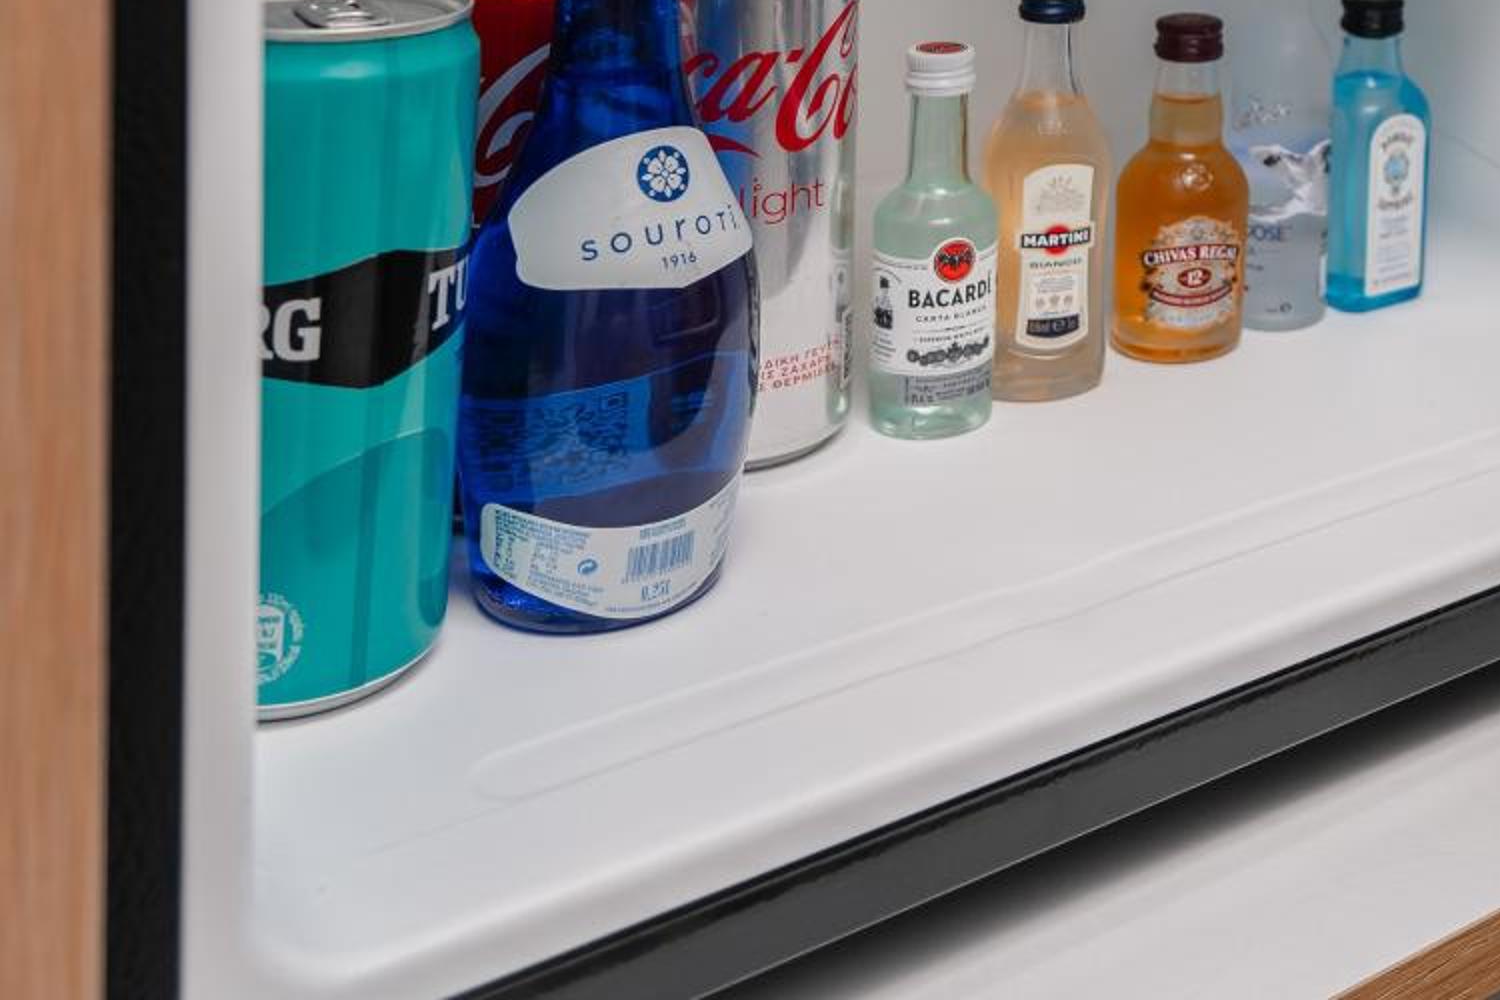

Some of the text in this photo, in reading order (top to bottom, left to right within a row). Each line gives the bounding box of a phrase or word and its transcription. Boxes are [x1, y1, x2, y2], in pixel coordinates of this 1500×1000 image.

[1023, 228, 1089, 247] MARTINI
[661, 251, 697, 269] 1916
[1143, 247, 1197, 266] CHIVAS
[908, 269, 992, 308] BACARDI
